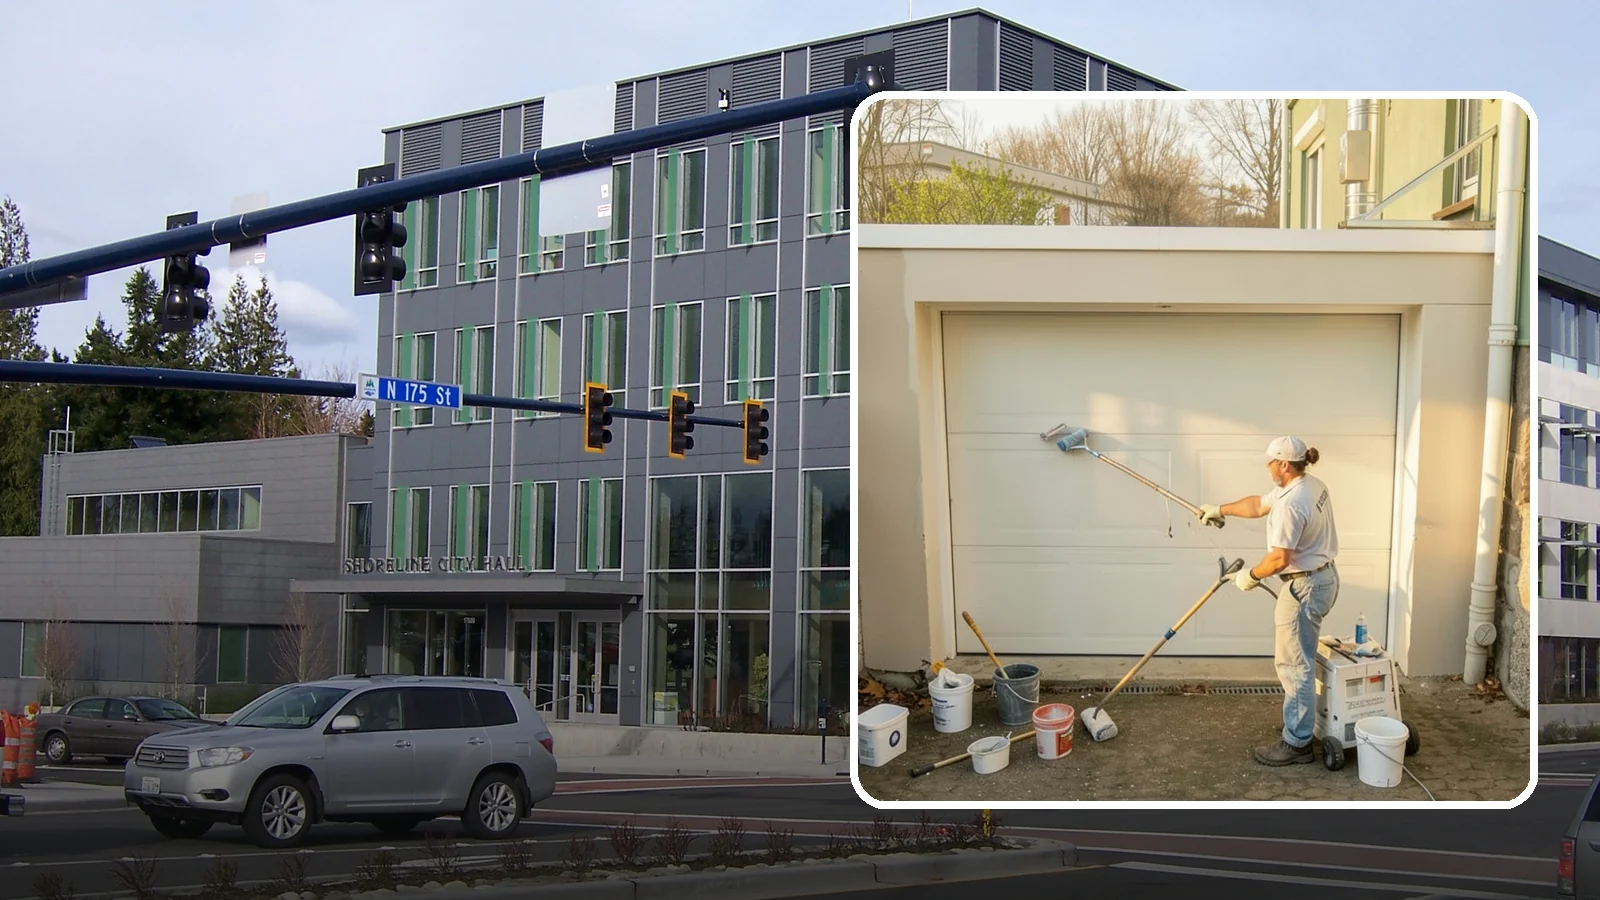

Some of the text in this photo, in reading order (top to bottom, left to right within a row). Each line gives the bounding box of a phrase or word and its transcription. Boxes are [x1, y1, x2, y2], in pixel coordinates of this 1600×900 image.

[387, 380, 451, 405] N 175 St
[344, 555, 525, 574] SHORELINE CITY HALL
